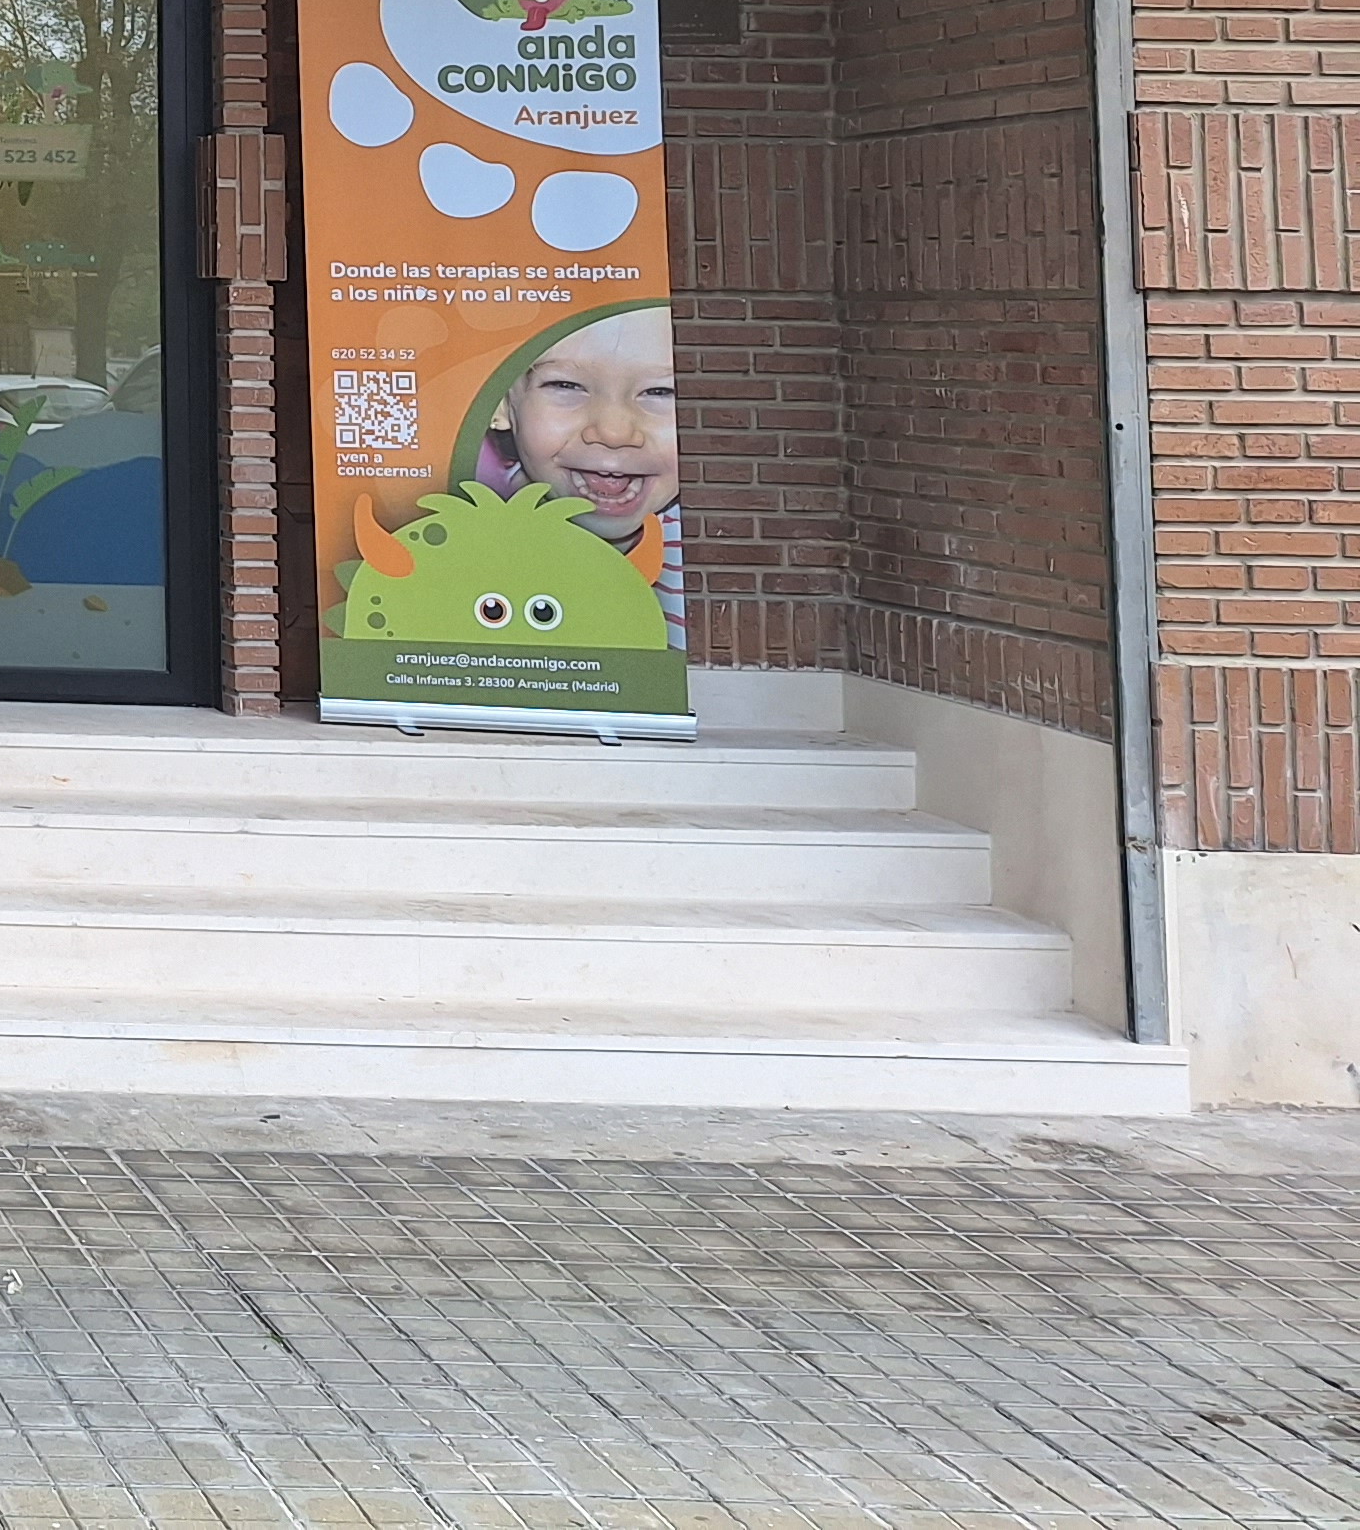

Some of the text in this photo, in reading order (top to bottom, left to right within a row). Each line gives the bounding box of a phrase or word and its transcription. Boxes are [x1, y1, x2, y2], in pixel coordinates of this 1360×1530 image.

[517, 25, 636, 59] anda
[514, 104, 639, 130] Aranjuez
[4, 149, 37, 163] 523
[43, 149, 78, 164] 452
[330, 262, 640, 284] Donde las terapias se adaptan
[330, 288, 343, 301] a
[348, 285, 378, 301] los
[443, 289, 456, 304] y
[461, 289, 487, 302] no
[493, 286, 511, 302] al
[517, 285, 572, 303] revés
[331, 348, 416, 360] 620 52 34 52
[336, 452, 383, 465] ¡ven a
[337, 465, 432, 478] conocernos!
[395, 652, 602, 672] aranjuez@andaconmigo.com
[386, 673, 415, 685] Calle
[416, 674, 462, 687] Infantas
[477, 676, 515, 688] 28300
[517, 678, 569, 692] Aranjuez
[571, 679, 620, 694] (Madrid)
